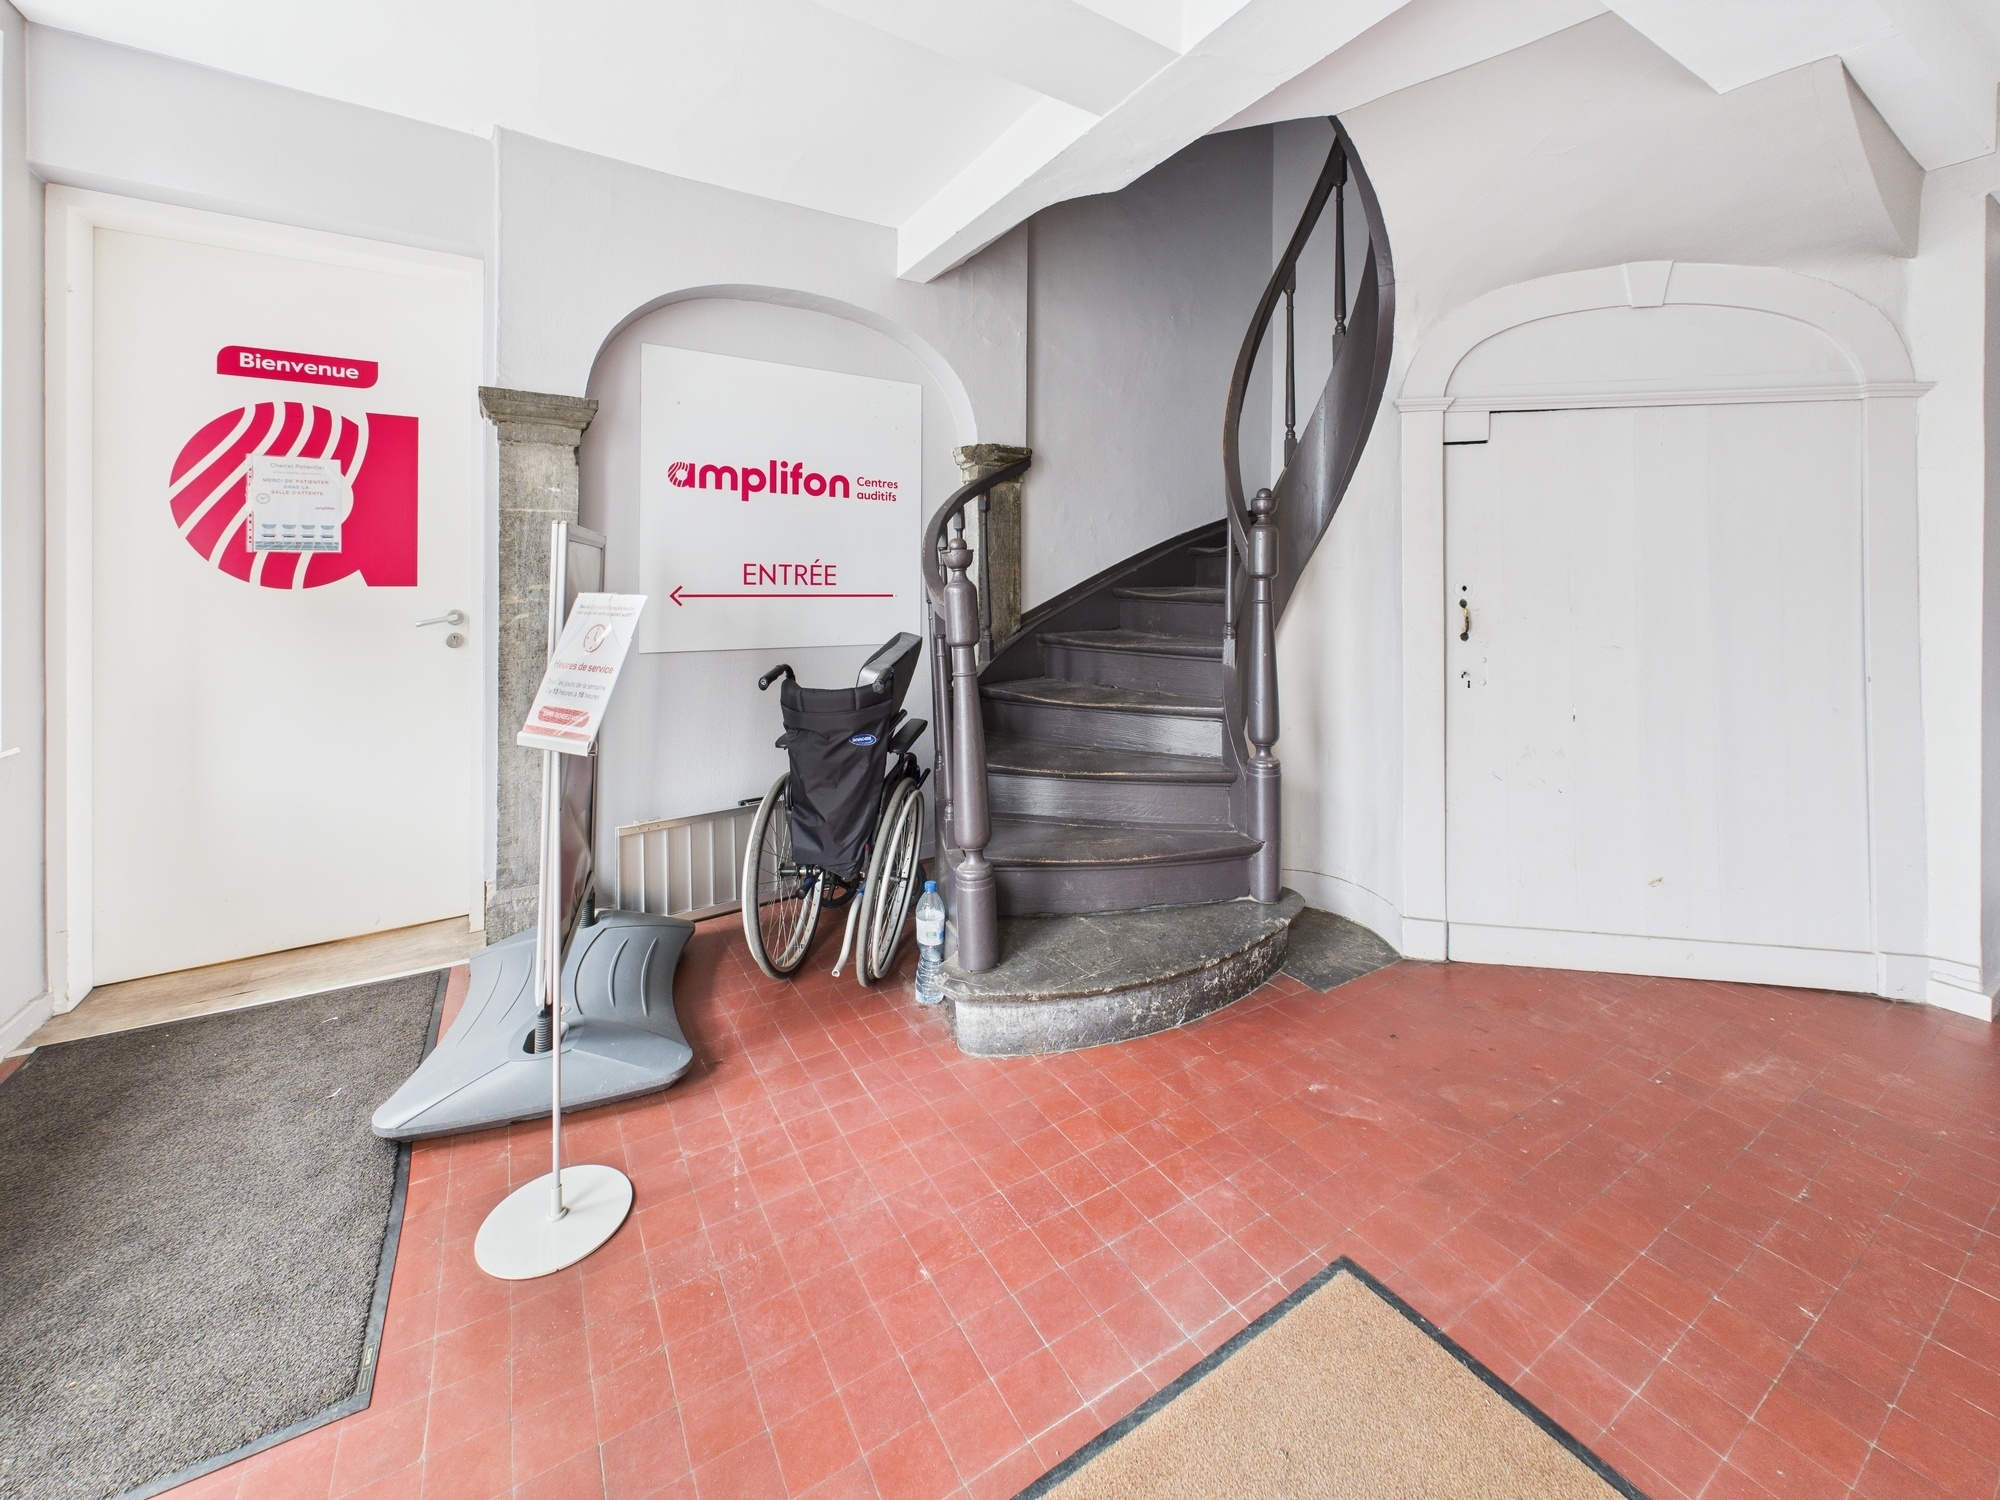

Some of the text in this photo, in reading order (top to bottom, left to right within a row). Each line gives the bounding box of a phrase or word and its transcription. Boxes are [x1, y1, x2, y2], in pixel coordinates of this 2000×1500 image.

[239, 351, 360, 380] Bienvenue
[667, 459, 850, 502] amplifon
[856, 476, 899, 490] Centres
[856, 490, 897, 502] auditifs
[743, 558, 837, 586] ENTRÉE
[553, 660, 614, 674] Heures de service
[552, 687, 559, 695] 15
